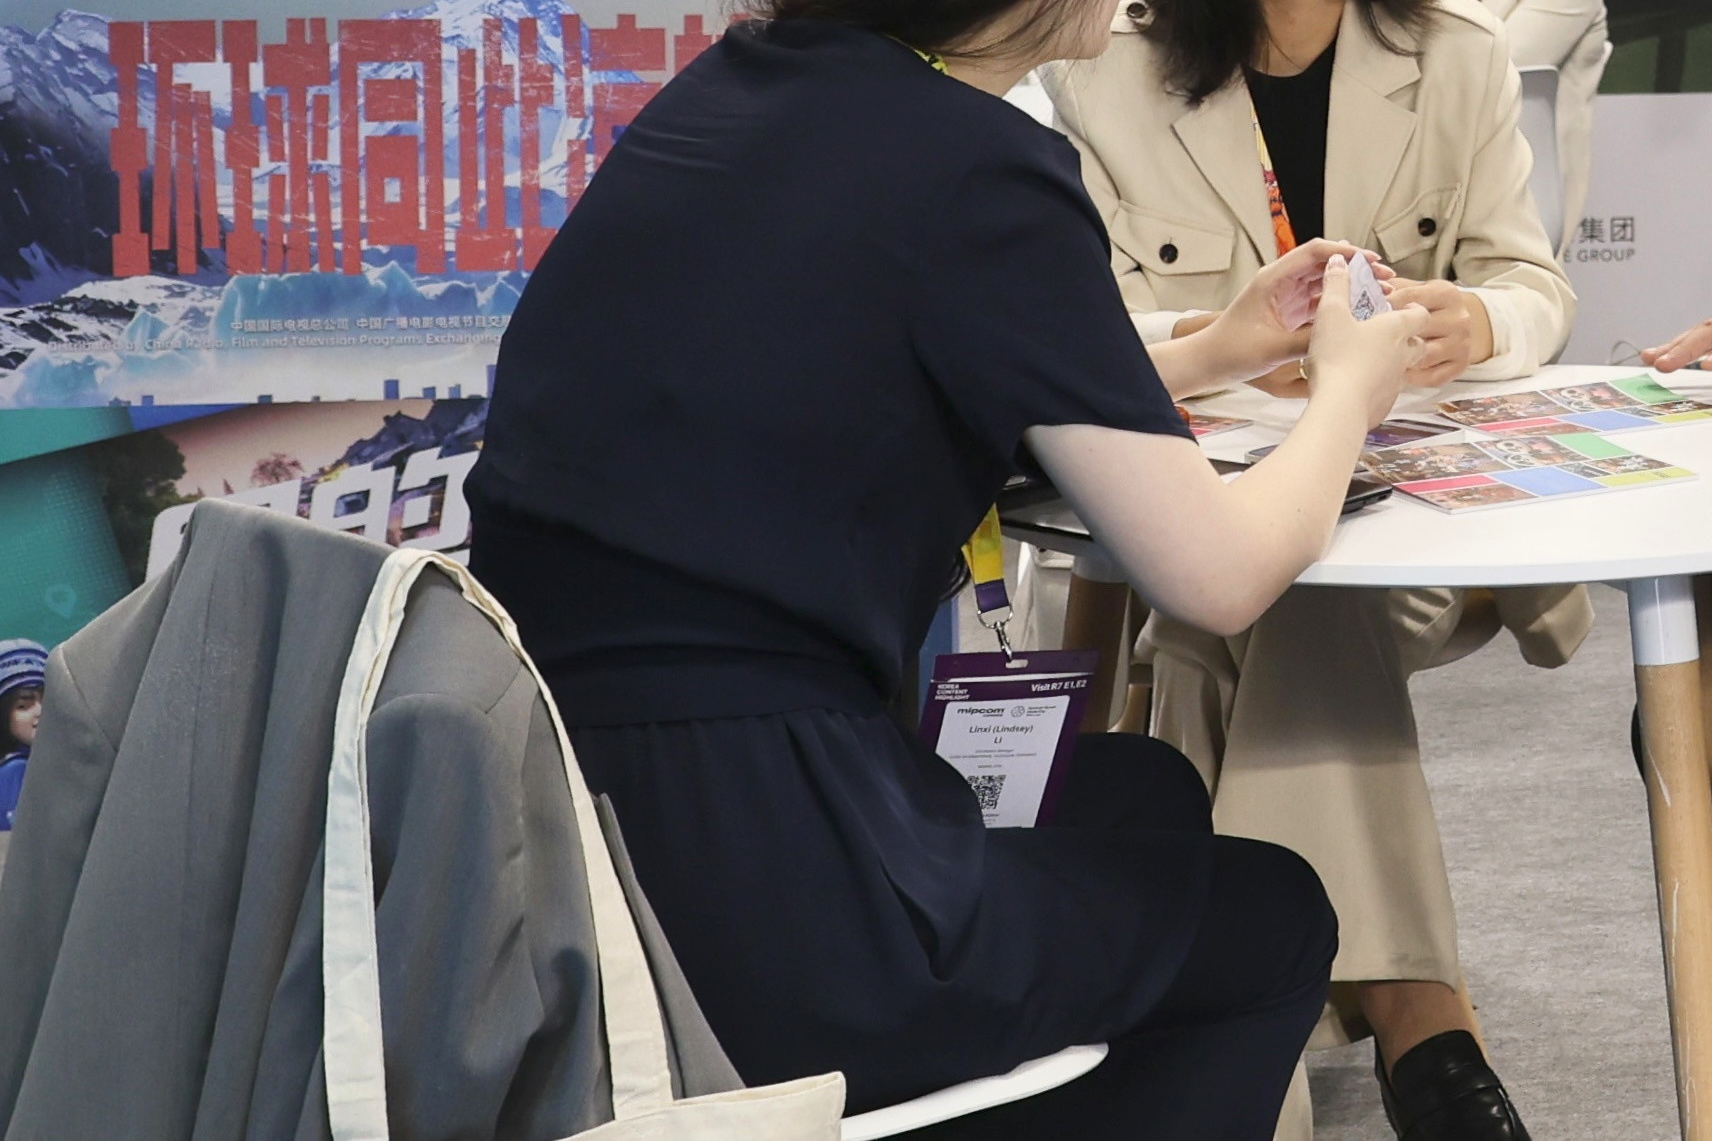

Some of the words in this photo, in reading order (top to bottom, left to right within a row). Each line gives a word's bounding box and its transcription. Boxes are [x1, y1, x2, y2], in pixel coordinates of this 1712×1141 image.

[1576, 249, 1635, 263] GROUP
[231, 336, 259, 349] Film
[262, 336, 288, 348] and
[291, 334, 356, 348] Television
[359, 334, 422, 348] Programs
[1031, 683, 1050, 693] Visit
[957, 707, 1006, 716] mipcom
[969, 724, 991, 734] Linxi
